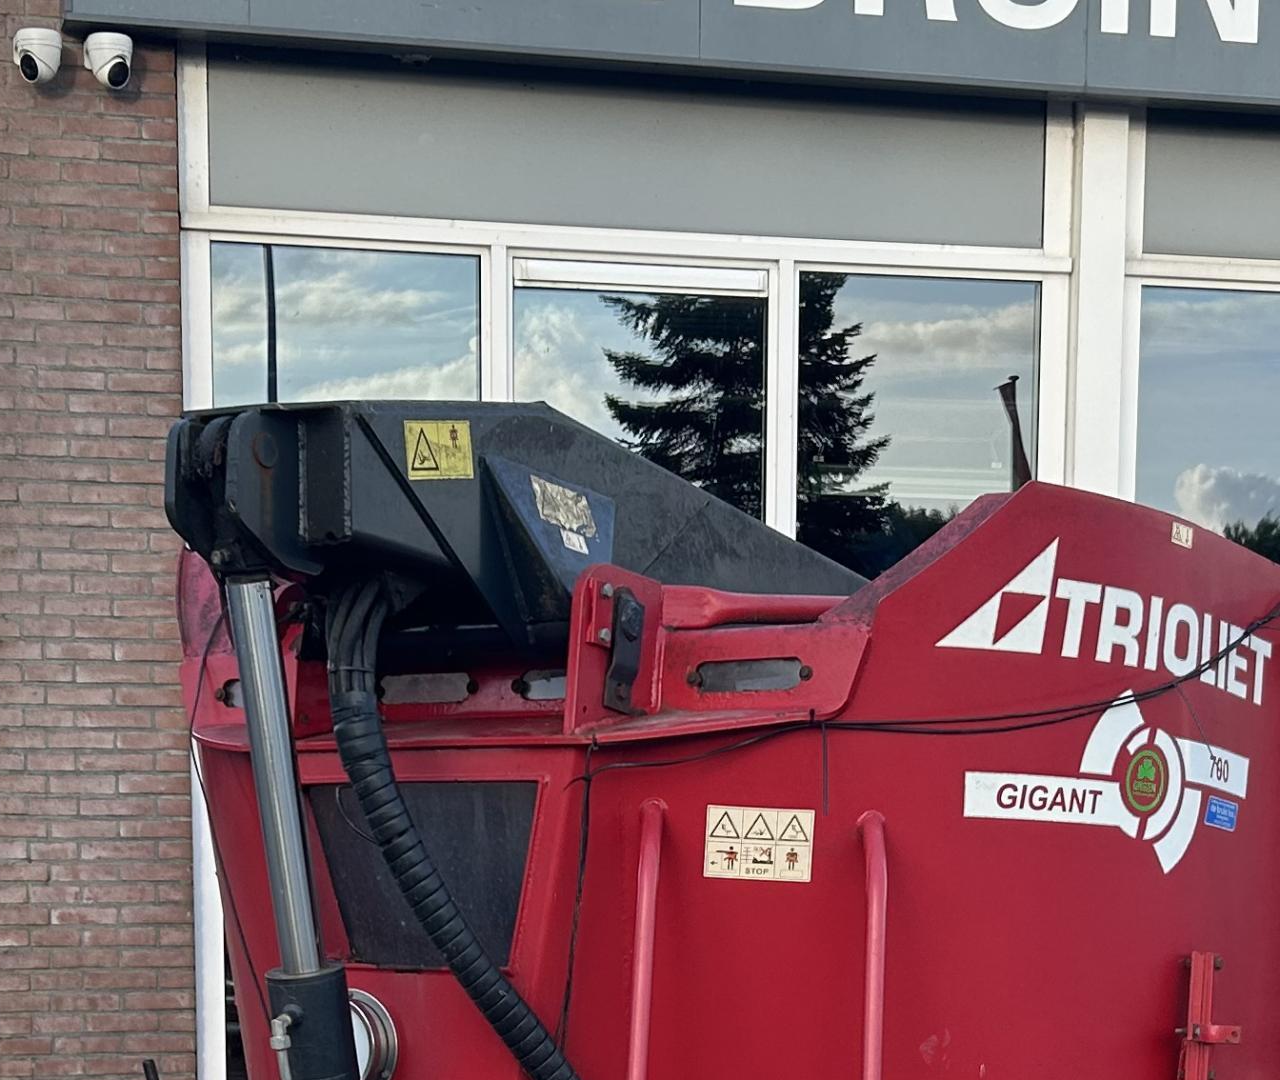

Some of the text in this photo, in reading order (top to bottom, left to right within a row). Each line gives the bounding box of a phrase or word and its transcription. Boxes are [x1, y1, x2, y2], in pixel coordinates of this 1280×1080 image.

[1055, 578, 1272, 706] TRIOLIET
[996, 783, 1103, 815] GIGANT
[745, 867, 769, 875] STOP
